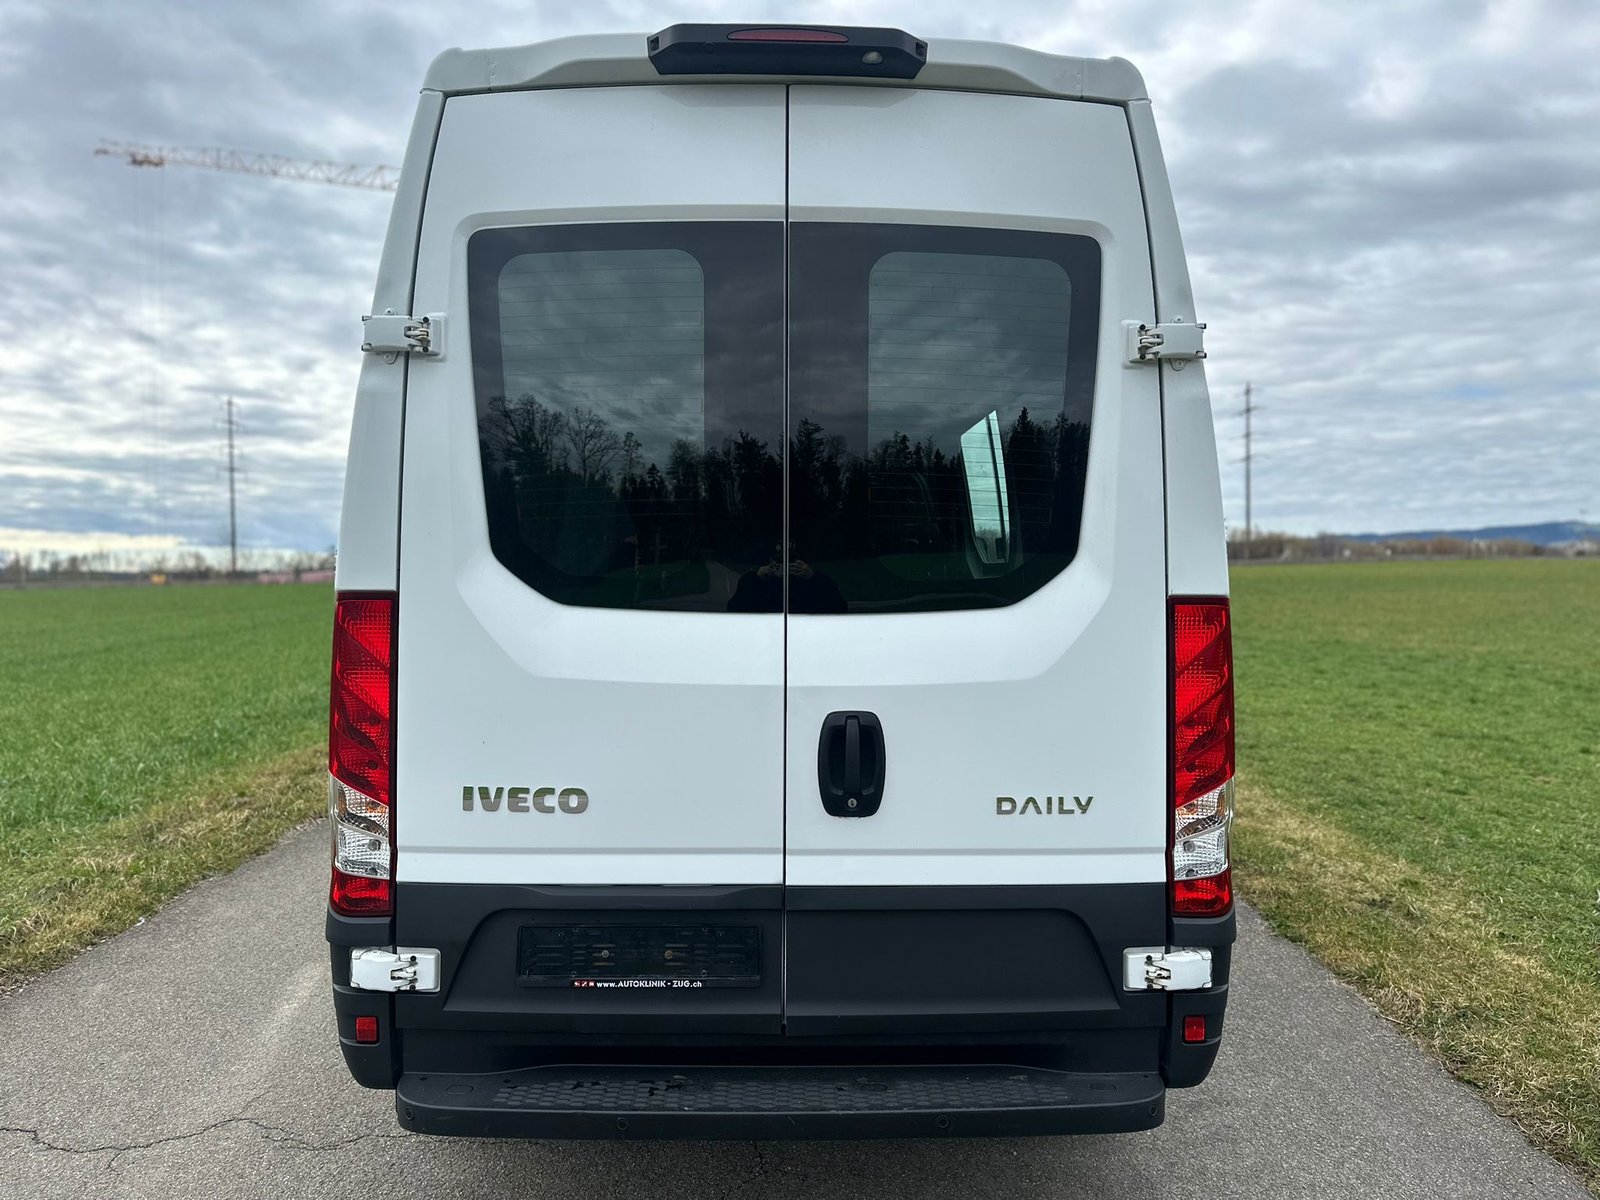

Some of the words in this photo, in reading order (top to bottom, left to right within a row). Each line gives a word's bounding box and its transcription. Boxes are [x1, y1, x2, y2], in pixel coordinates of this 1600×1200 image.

[463, 786, 589, 814] IVECO
[996, 796, 1094, 815] DAILY
[596, 980, 666, 988] www.AUTOKLINIK
[672, 980, 702, 988] ZUG.ch
